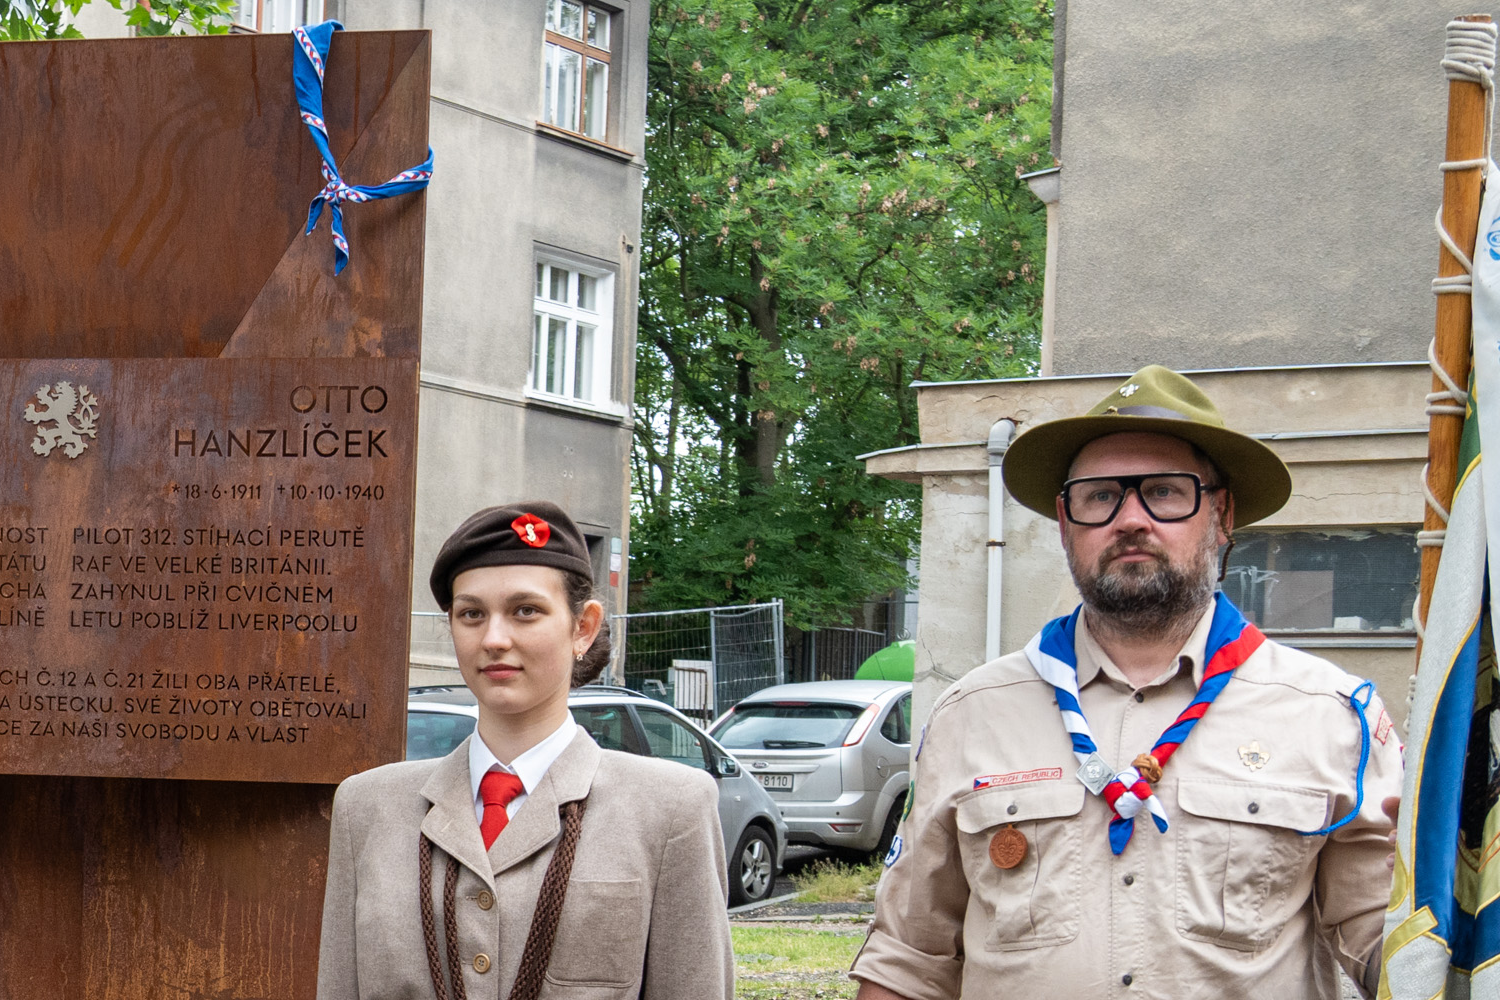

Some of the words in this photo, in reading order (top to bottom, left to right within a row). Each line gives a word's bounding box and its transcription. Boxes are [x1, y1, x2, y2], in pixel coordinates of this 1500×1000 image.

[290, 386, 388, 414] OTTO
[174, 422, 388, 458] HANZLÍČEK
[73, 527, 134, 545] PILOT
[140, 528, 176, 546] 312.
[183, 526, 272, 547] STÍHACÍ
[280, 526, 364, 548] PERUTĚ
[72, 556, 112, 573] RAF
[120, 556, 146, 573] VE
[154, 554, 222, 574] VELKÉ
[231, 554, 331, 576] BRITÁNII.
[71, 583, 175, 601] ZAHYNUL
[184, 580, 216, 601] PŘI
[226, 582, 332, 603] CVIČNÉM
[70, 610, 122, 628] LETU
[132, 608, 209, 630] POBLÍŽ
[218, 612, 358, 632] LIVERPOOLU
[84, 672, 96, 687] A
[152, 670, 188, 689] ŽILI
[196, 674, 240, 690] OBA
[248, 672, 341, 694] PŘÁTELÉ,
[19, 692, 117, 713] ÚSTECKU.
[124, 694, 160, 714] SVÉ
[168, 694, 242, 716] ŽIVOTY
[250, 698, 366, 719] OBĚTOVALI
[30, 720, 55, 736] ZA
[62, 720, 108, 738] NAŠI
[116, 723, 219, 742] SVOBODU
[227, 726, 240, 742] A
[246, 726, 310, 744] VLAST
[992, 776, 1018, 784] CZECH
[1022, 770, 1058, 780] REPUBLIC
